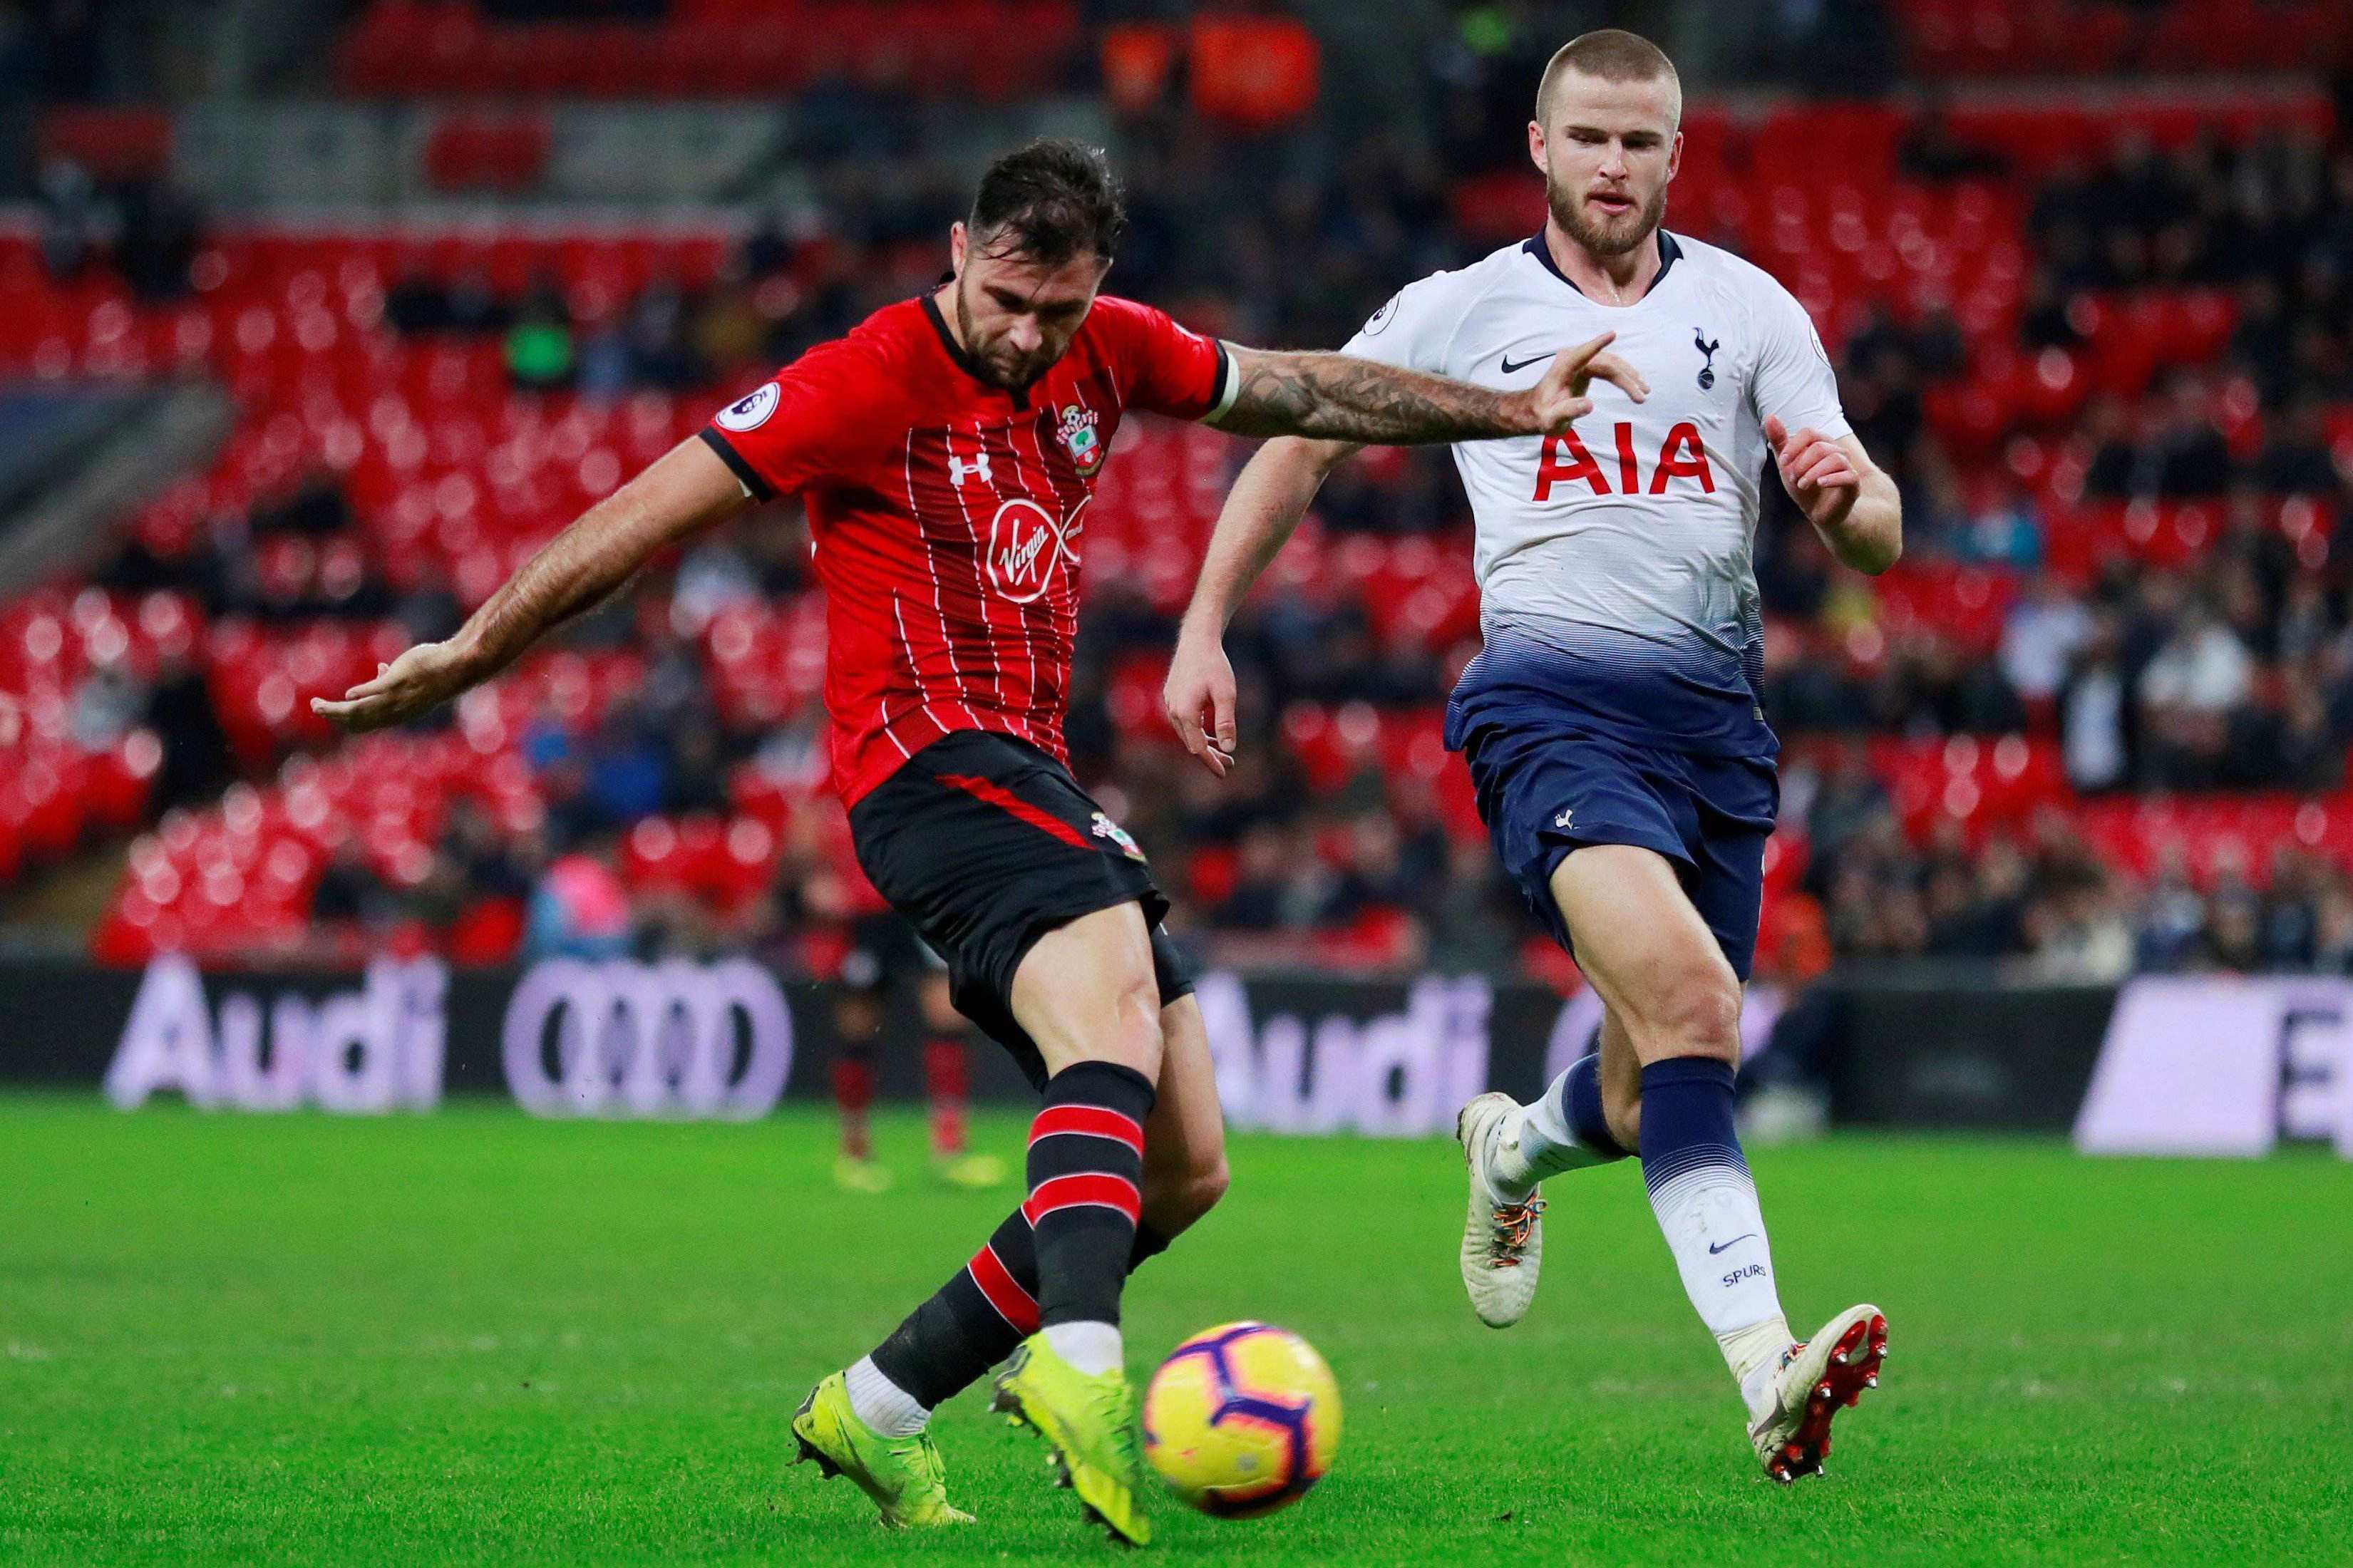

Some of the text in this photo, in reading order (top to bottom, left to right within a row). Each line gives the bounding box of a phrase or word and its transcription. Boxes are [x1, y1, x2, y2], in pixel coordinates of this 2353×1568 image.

[1533, 422, 1716, 501] AIA
[999, 519, 1049, 586] Virgin
[105, 951, 450, 1113] Audi
[1723, 1264, 1766, 1287] SPURS
